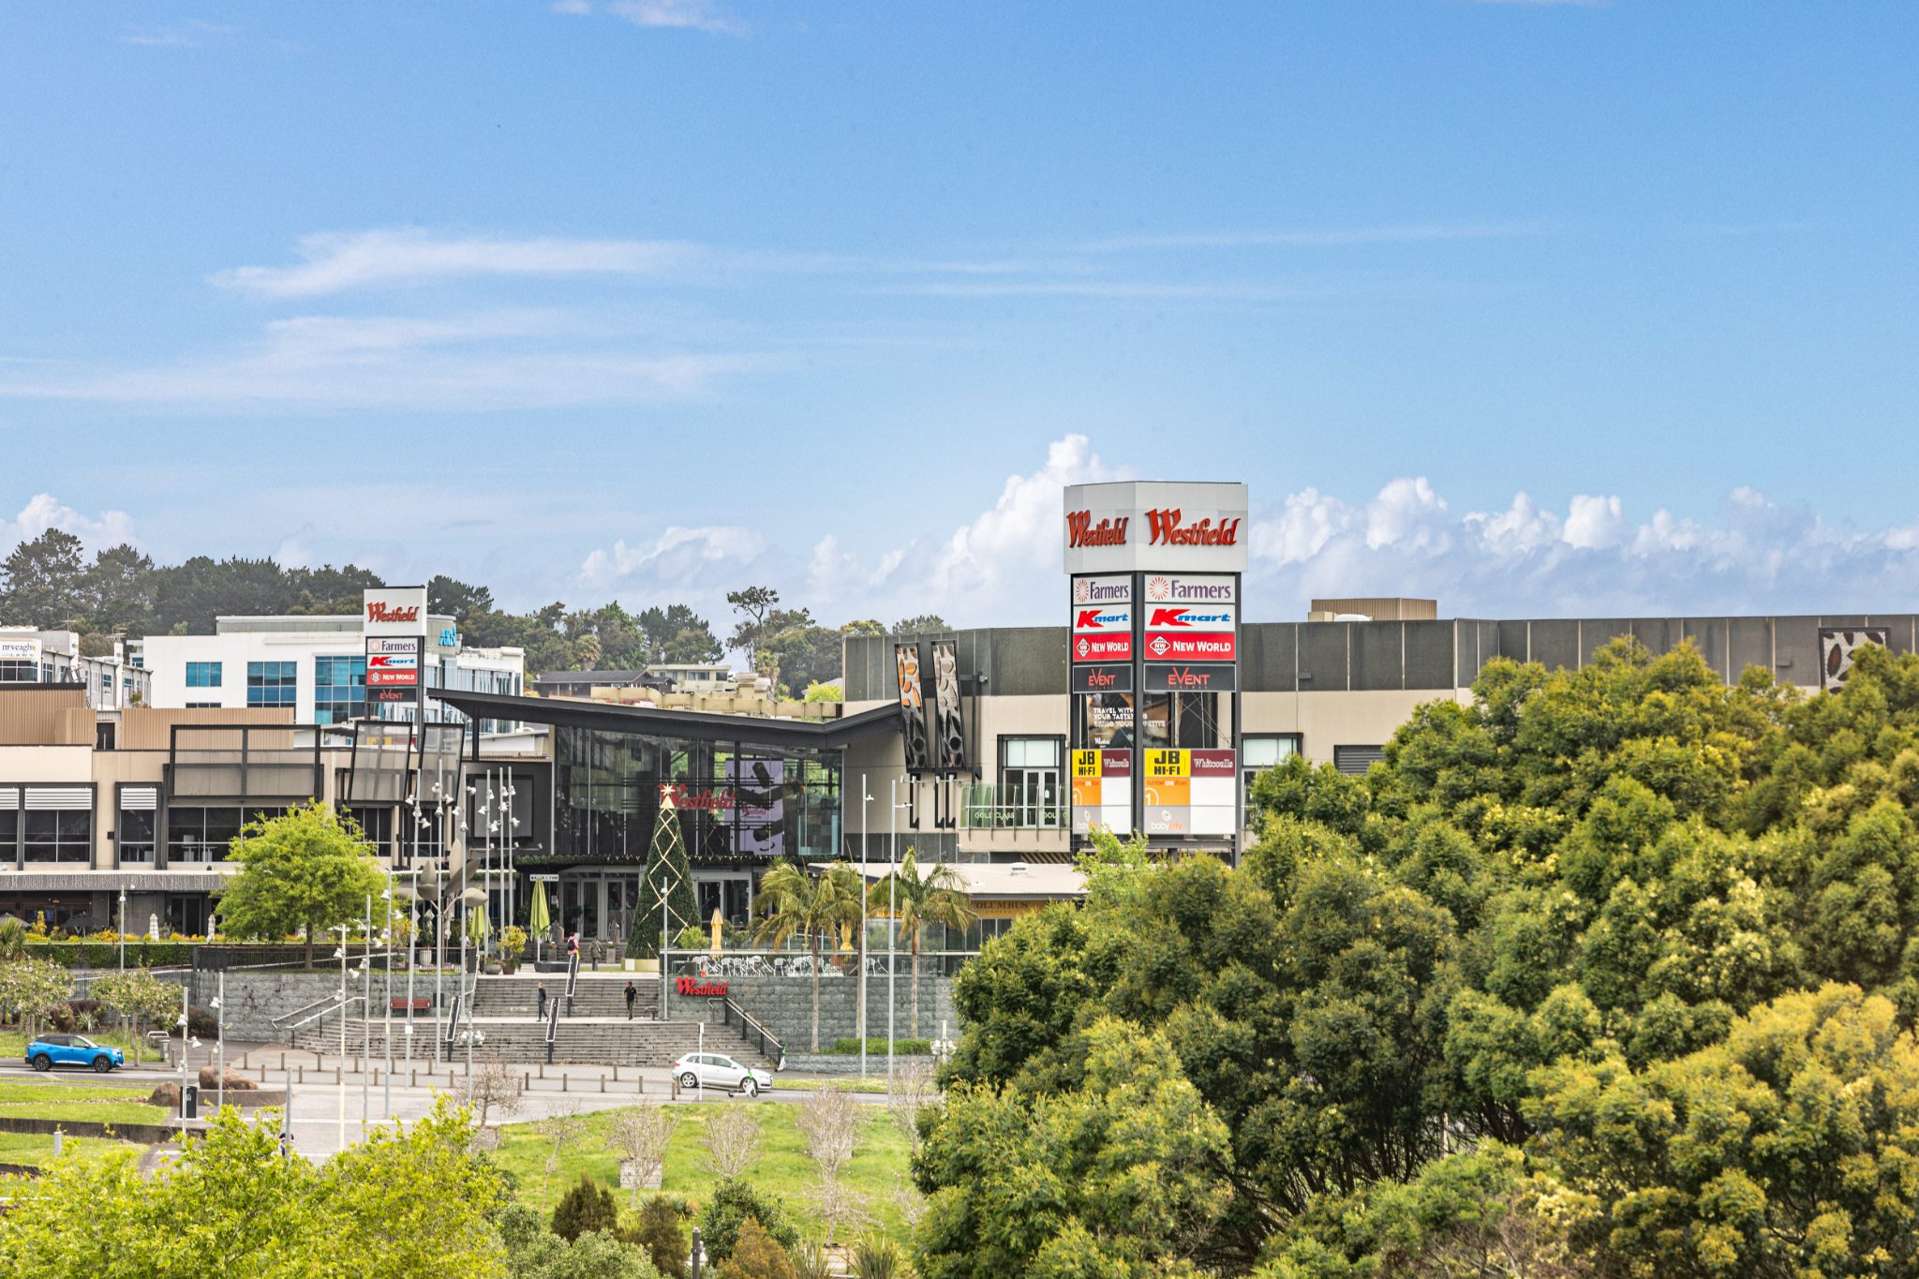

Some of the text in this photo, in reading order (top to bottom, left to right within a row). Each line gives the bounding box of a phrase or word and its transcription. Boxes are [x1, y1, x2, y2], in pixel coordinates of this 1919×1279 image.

[1066, 508, 1129, 548] Westfield
[1145, 508, 1241, 546] Westfield
[1090, 581, 1128, 600] Farmers
[1171, 580, 1231, 599] Farmers
[367, 601, 419, 623] Westfield
[1077, 608, 1128, 628] Kmart
[1149, 608, 1231, 626] Kmart
[381, 640, 416, 652] Farmers
[1091, 642, 1106, 653] NEW
[1107, 641, 1129, 652] WORLD
[1173, 641, 1232, 652] NEW WORLD
[1078, 751, 1095, 765] JB
[1154, 750, 1181, 765] JB
[675, 976, 730, 996] Westfield
